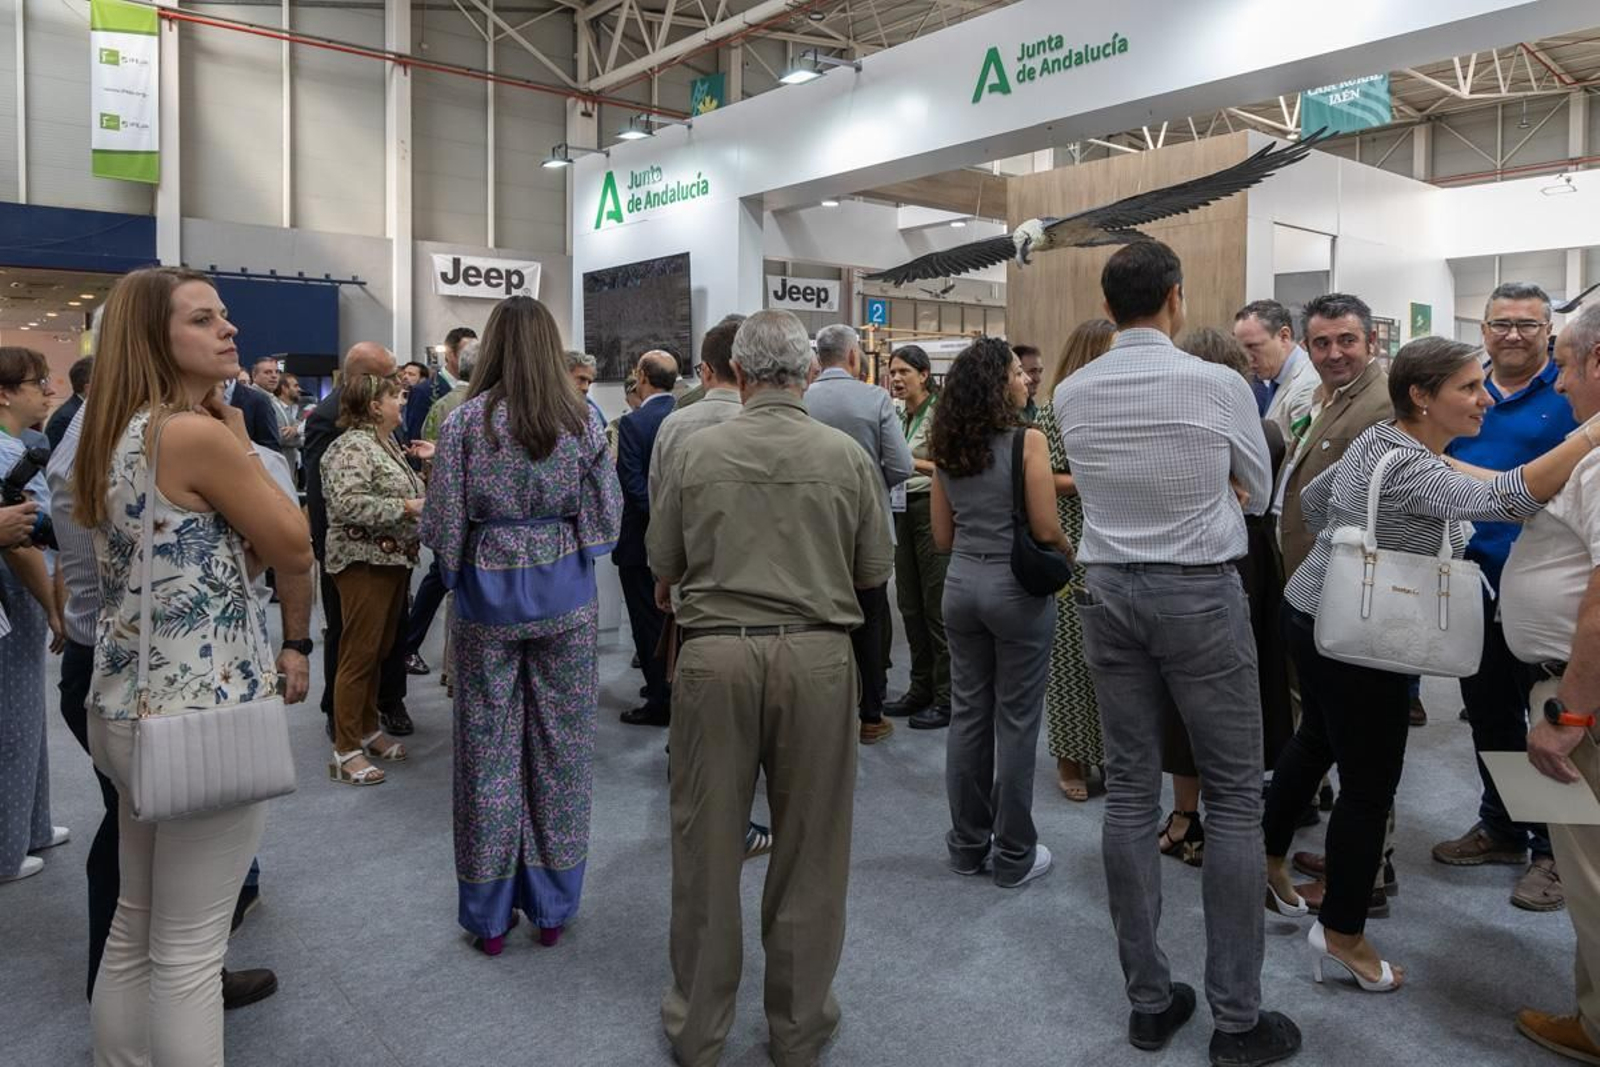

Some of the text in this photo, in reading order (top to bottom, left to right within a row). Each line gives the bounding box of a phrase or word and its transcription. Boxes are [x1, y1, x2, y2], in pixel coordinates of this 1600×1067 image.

[1016, 33, 1064, 62] Junta
[1016, 32, 1128, 84] de Andalucía
[627, 165, 662, 190] Junta
[627, 171, 709, 214] de Andalucía
[440, 257, 525, 295] Jeep
[773, 278, 829, 308] Jeep
[872, 303, 883, 322] 2
